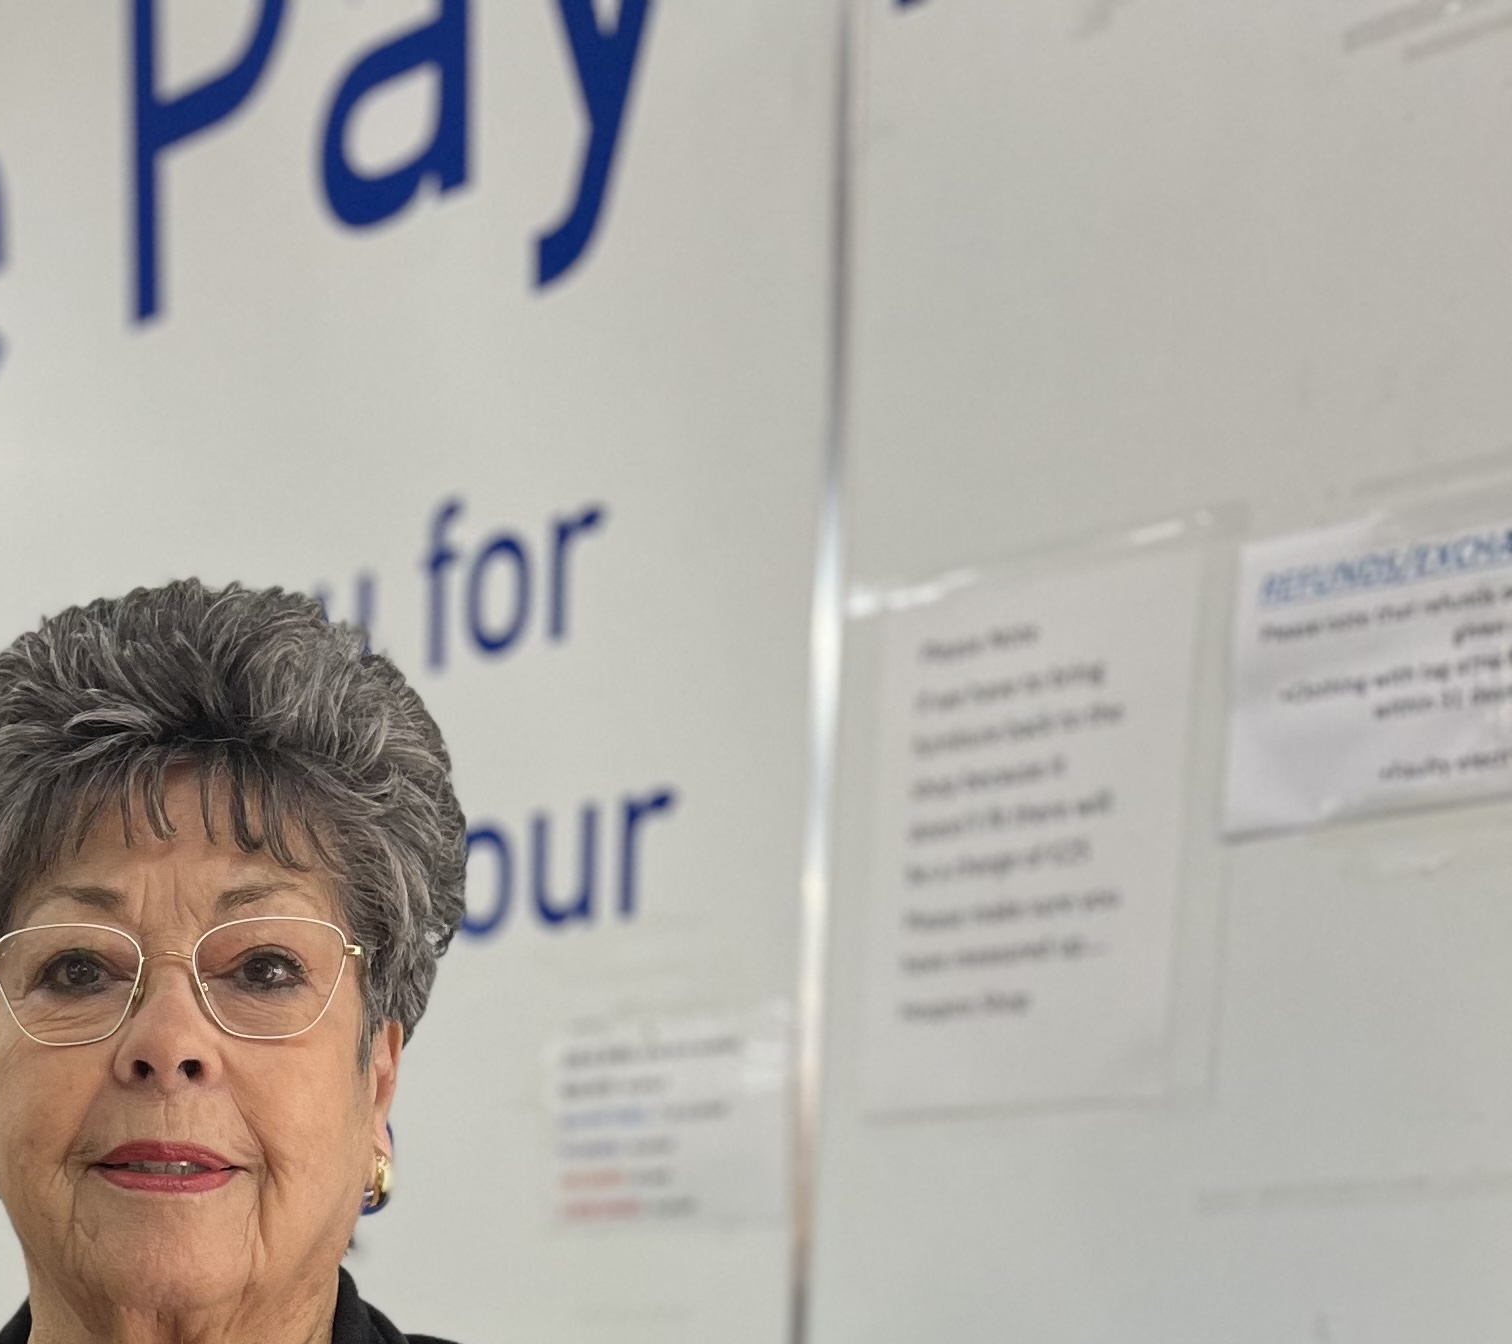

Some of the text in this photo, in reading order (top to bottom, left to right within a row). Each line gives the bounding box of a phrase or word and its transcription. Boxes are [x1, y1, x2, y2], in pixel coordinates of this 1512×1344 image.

[130, 0, 655, 332] Pay
[419, 496, 609, 673] for
[461, 784, 679, 944] our
